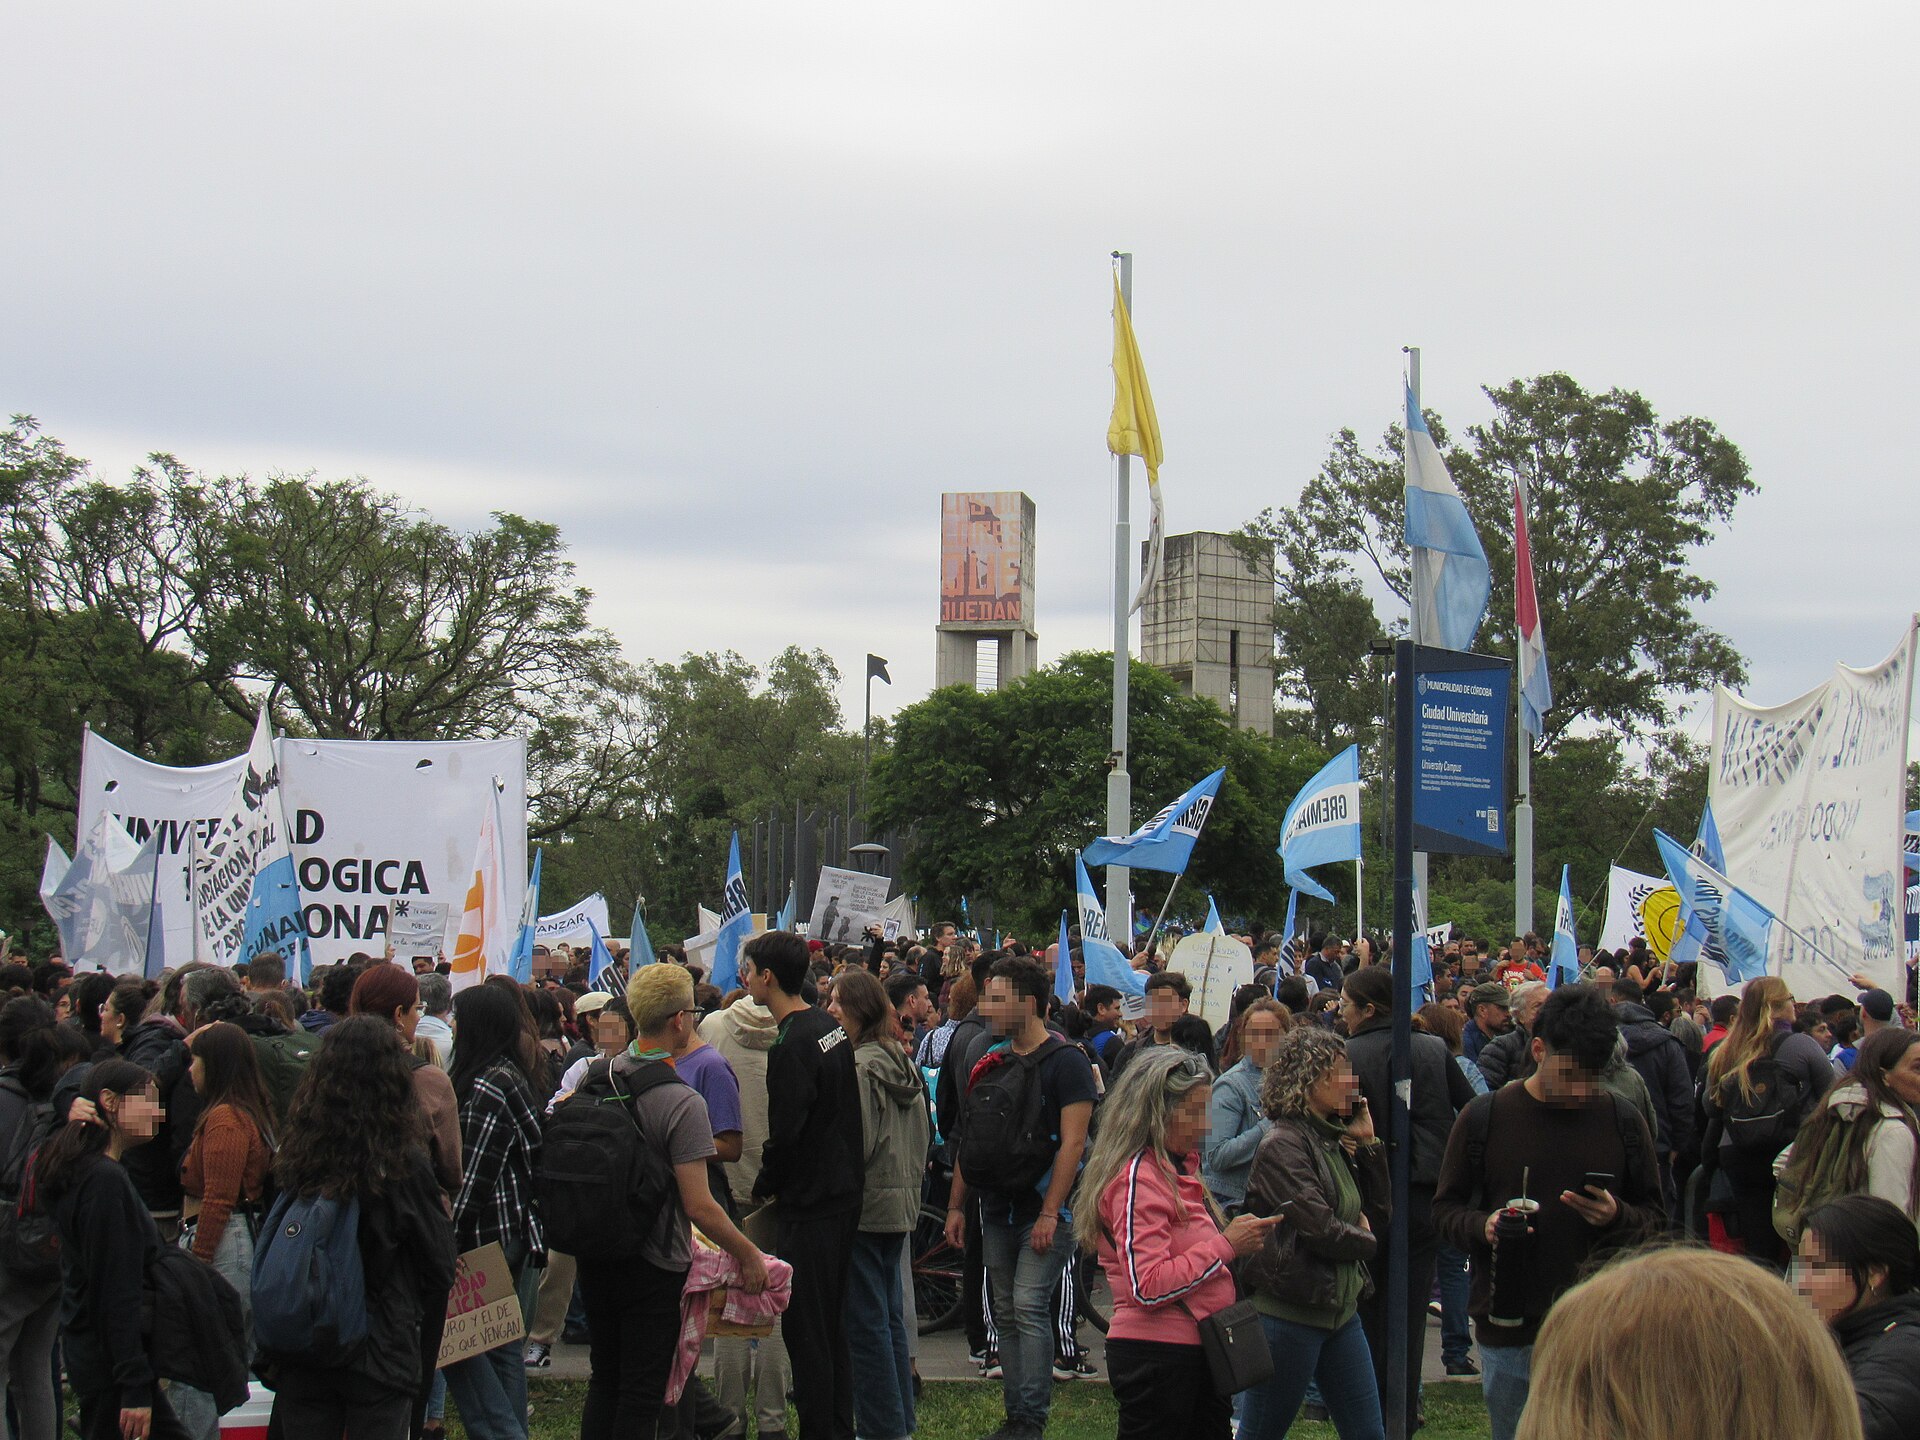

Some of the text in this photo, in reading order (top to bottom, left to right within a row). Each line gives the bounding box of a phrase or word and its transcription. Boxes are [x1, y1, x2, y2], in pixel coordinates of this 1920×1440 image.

[1427, 680, 1463, 694] MUNICIPALIDAD
[1463, 685, 1471, 695] DE
[1421, 703, 1489, 725] Ciudad Universitaria
[1421, 759, 1463, 774] University Campus
[535, 912, 585, 934] ANZAR
[1191, 943, 1241, 958] UNIERSIDAD
[471, 1314, 478, 1328] Y
[497, 1301, 513, 1321] DE
[458, 1333, 478, 1352] QUE
[480, 1317, 521, 1346] VENGAN
